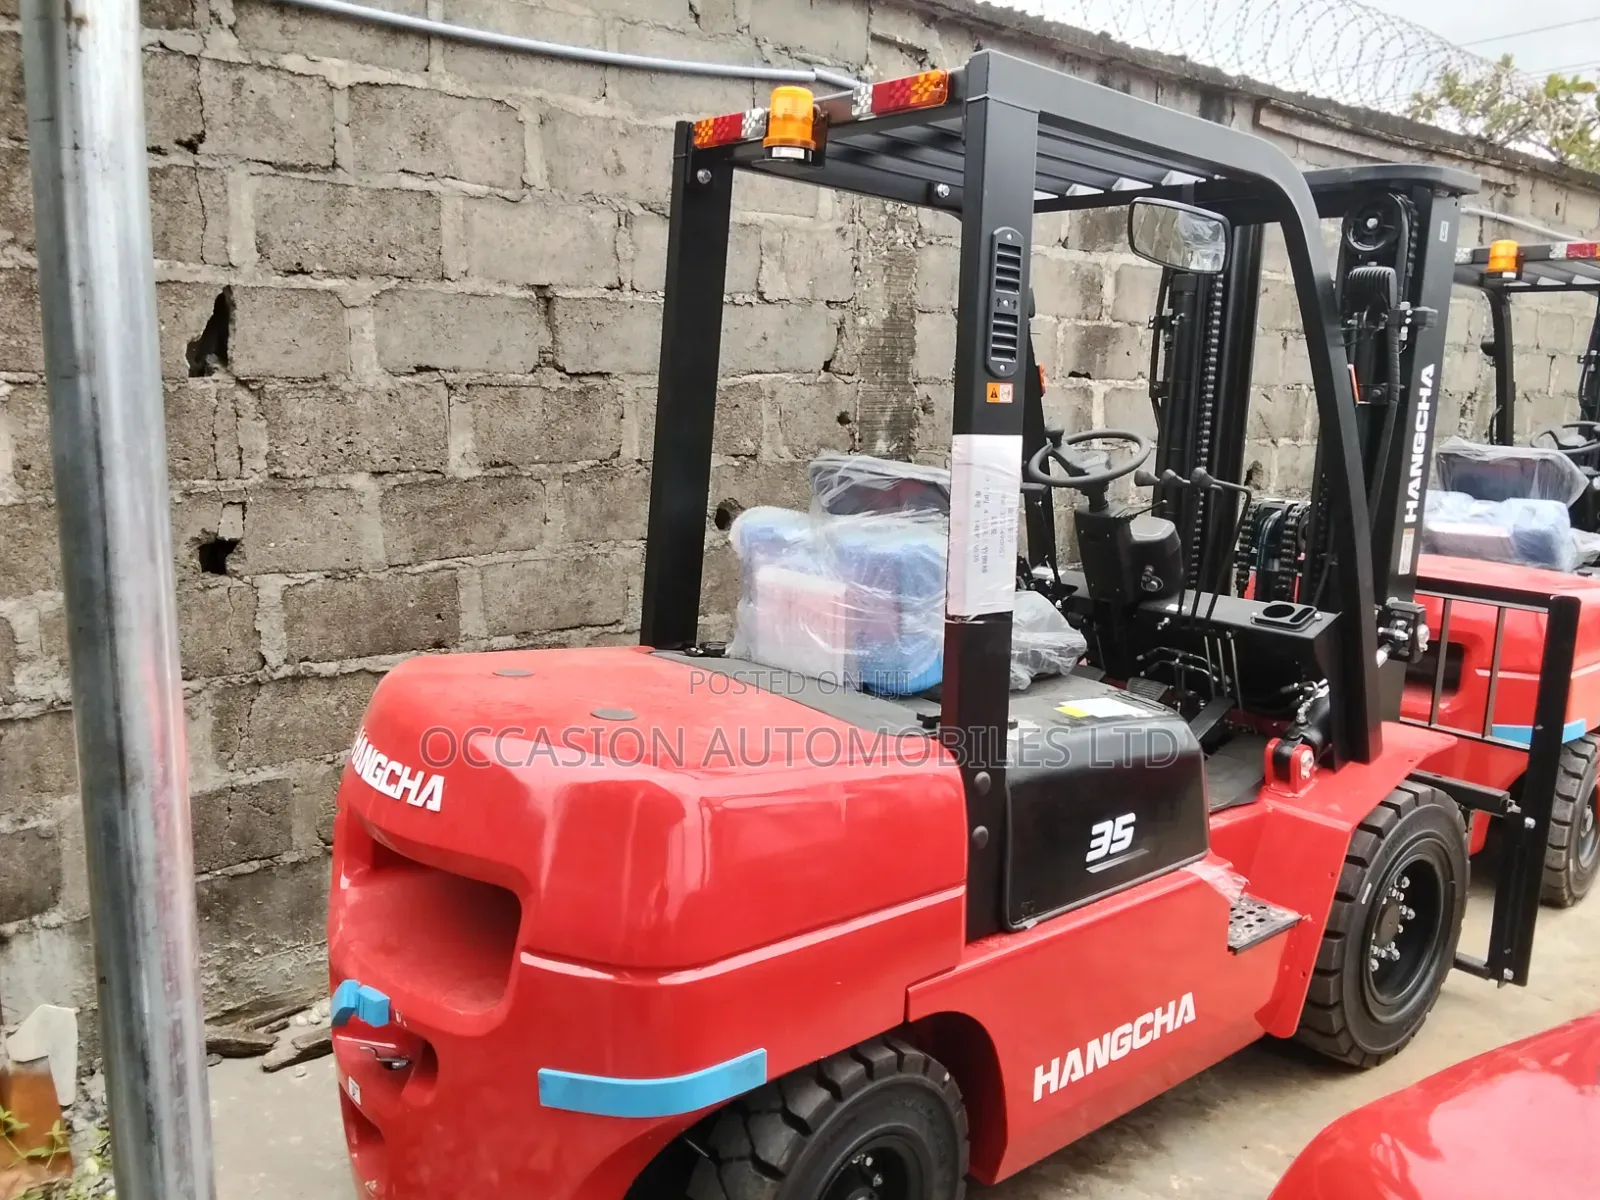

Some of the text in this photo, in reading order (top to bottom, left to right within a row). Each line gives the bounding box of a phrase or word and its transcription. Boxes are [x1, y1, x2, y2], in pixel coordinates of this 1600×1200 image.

[1404, 363, 1436, 524] HANGCHA
[1085, 812, 1137, 863] 35
[1033, 991, 1197, 1103] HANGCHA
